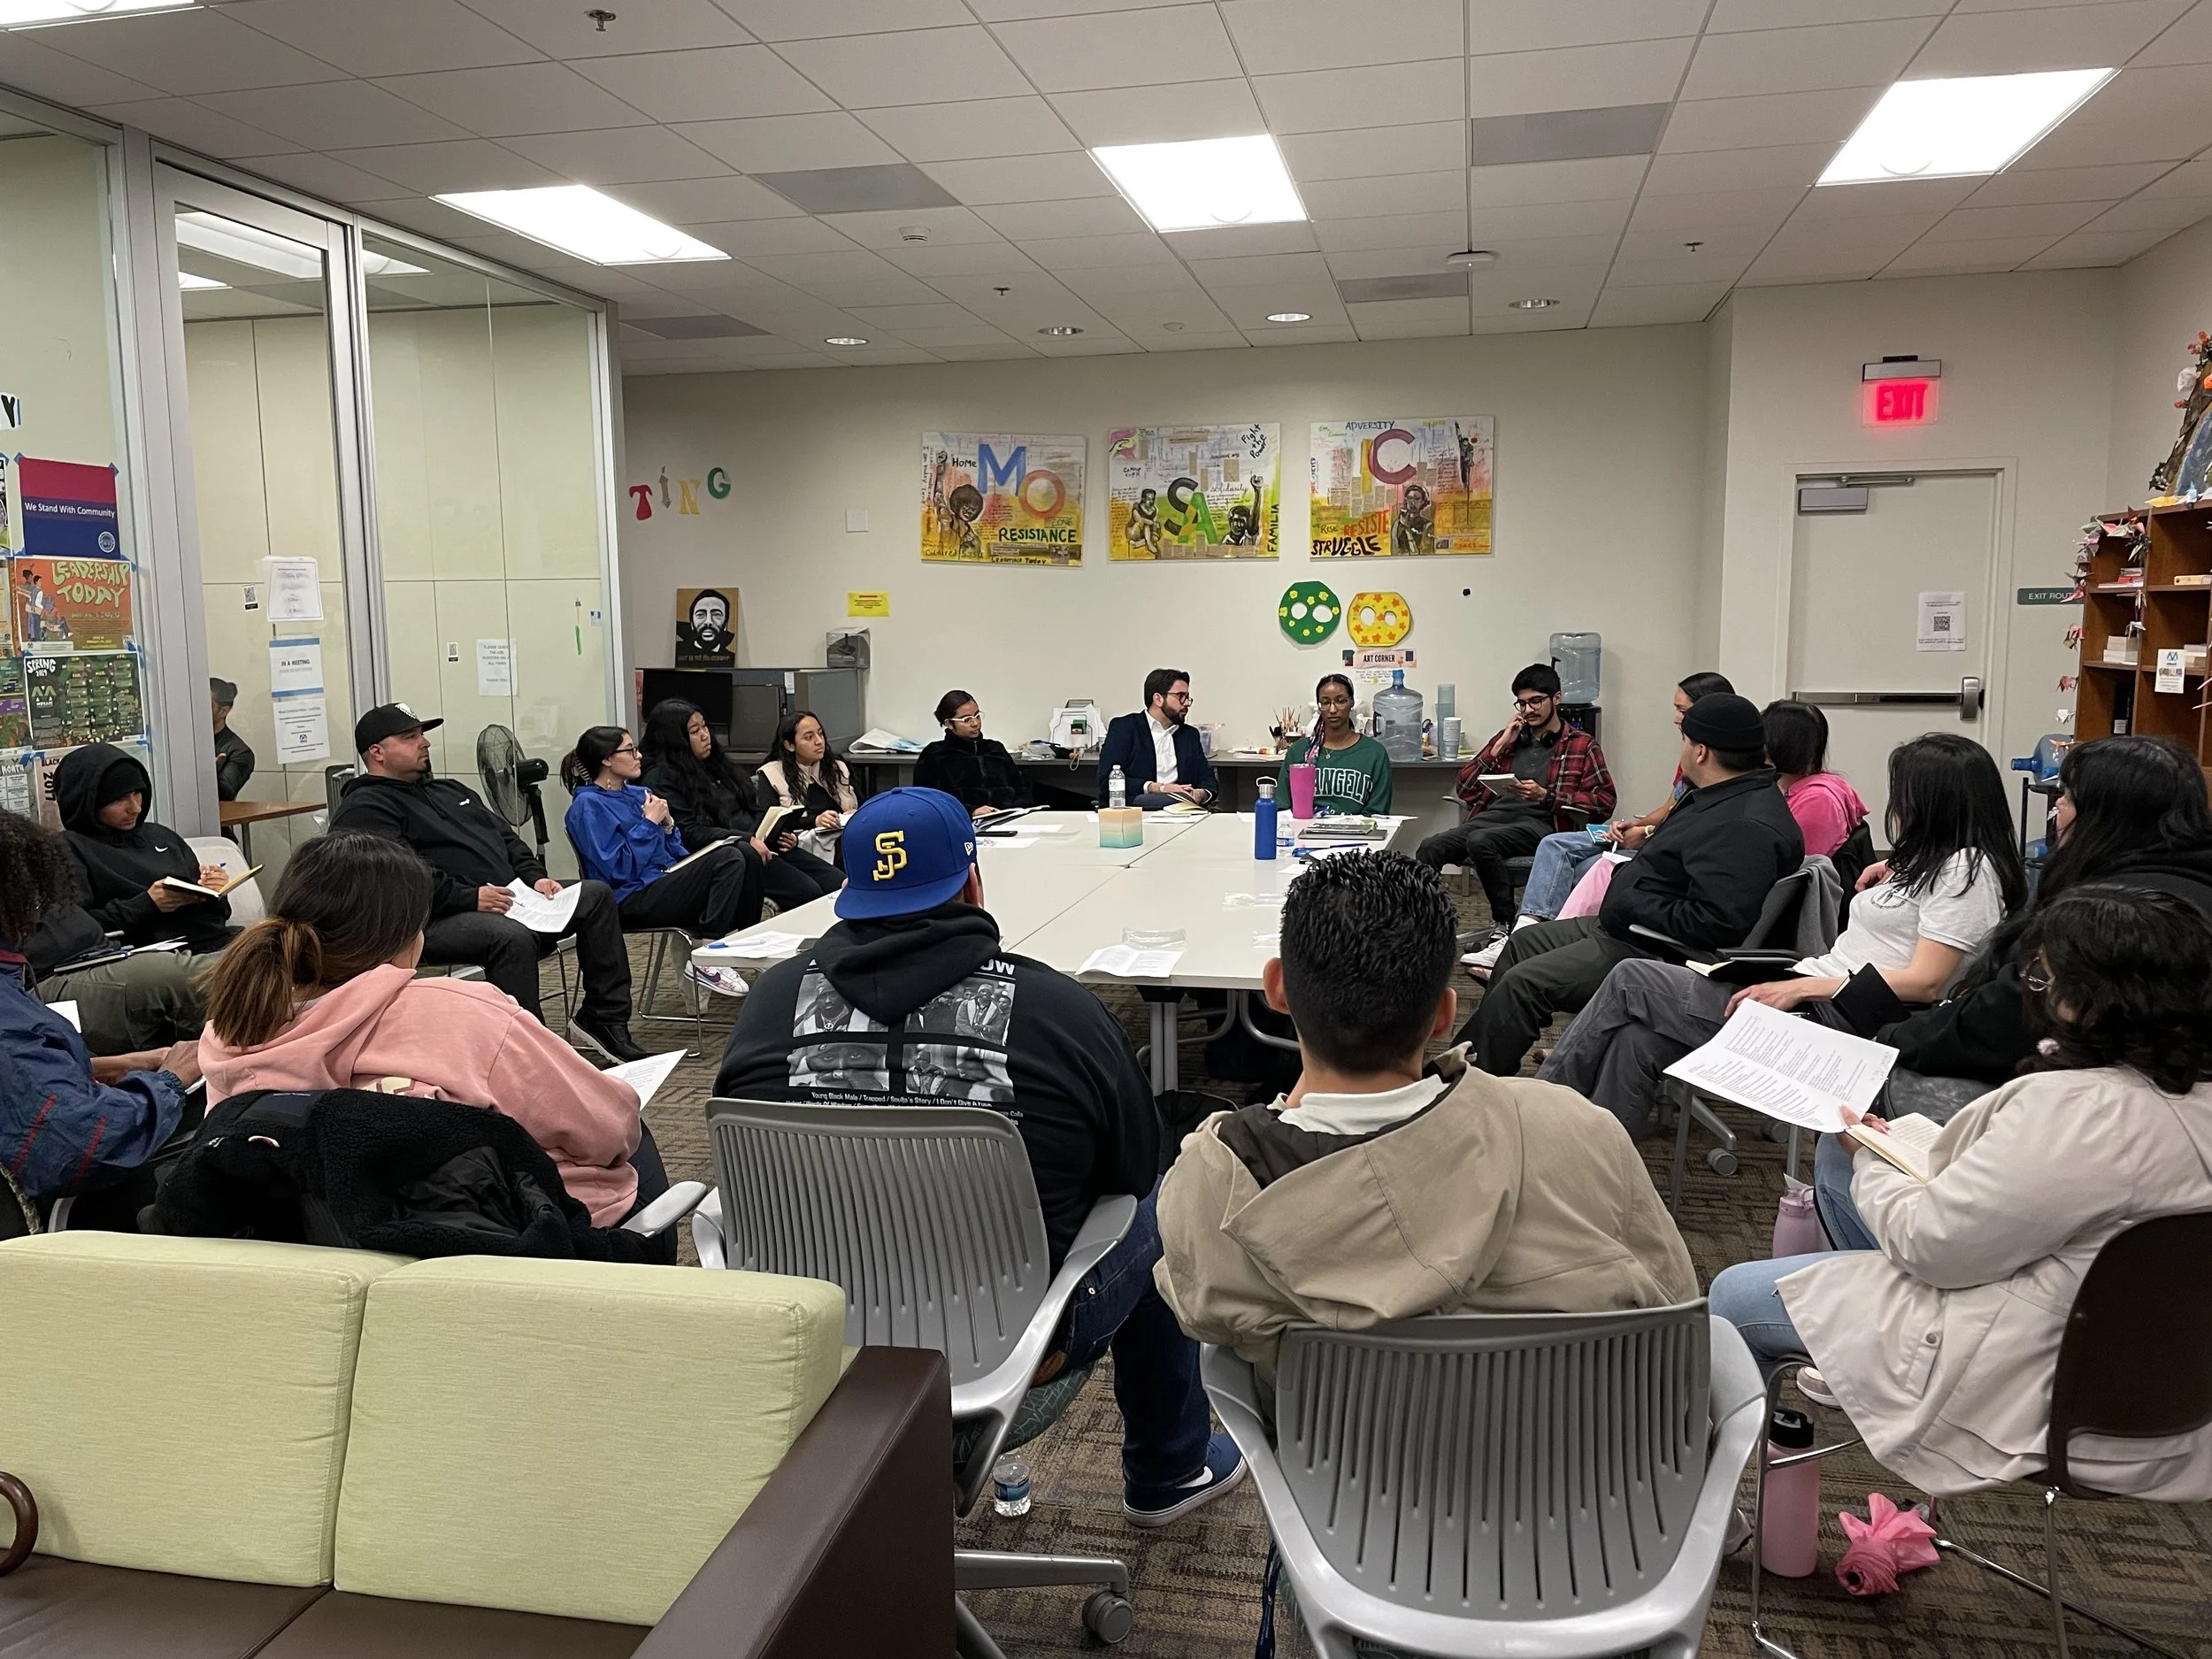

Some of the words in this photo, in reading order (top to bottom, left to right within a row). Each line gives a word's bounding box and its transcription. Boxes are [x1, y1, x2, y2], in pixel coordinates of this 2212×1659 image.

[1877, 383, 1928, 420] EXIT
[1241, 424, 1262, 444] Fight
[1346, 421, 1395, 431] ADVERSITY
[952, 457, 978, 468] Home
[25, 502, 36, 511] We
[38, 503, 58, 513] Stand
[77, 506, 115, 518] Community
[999, 527, 1077, 542] RESISTANCE
[1267, 503, 1279, 553] FAMILIA
[1311, 535, 1382, 556] STRUGGLE
[51, 561, 130, 587] LEADERSHIP
[57, 581, 125, 609] TODAY
[27, 658, 57, 673] SPRING
[1374, 654, 1395, 663] CORNER
[872, 830, 908, 881] SJ
[811, 1092, 827, 1101] Young
